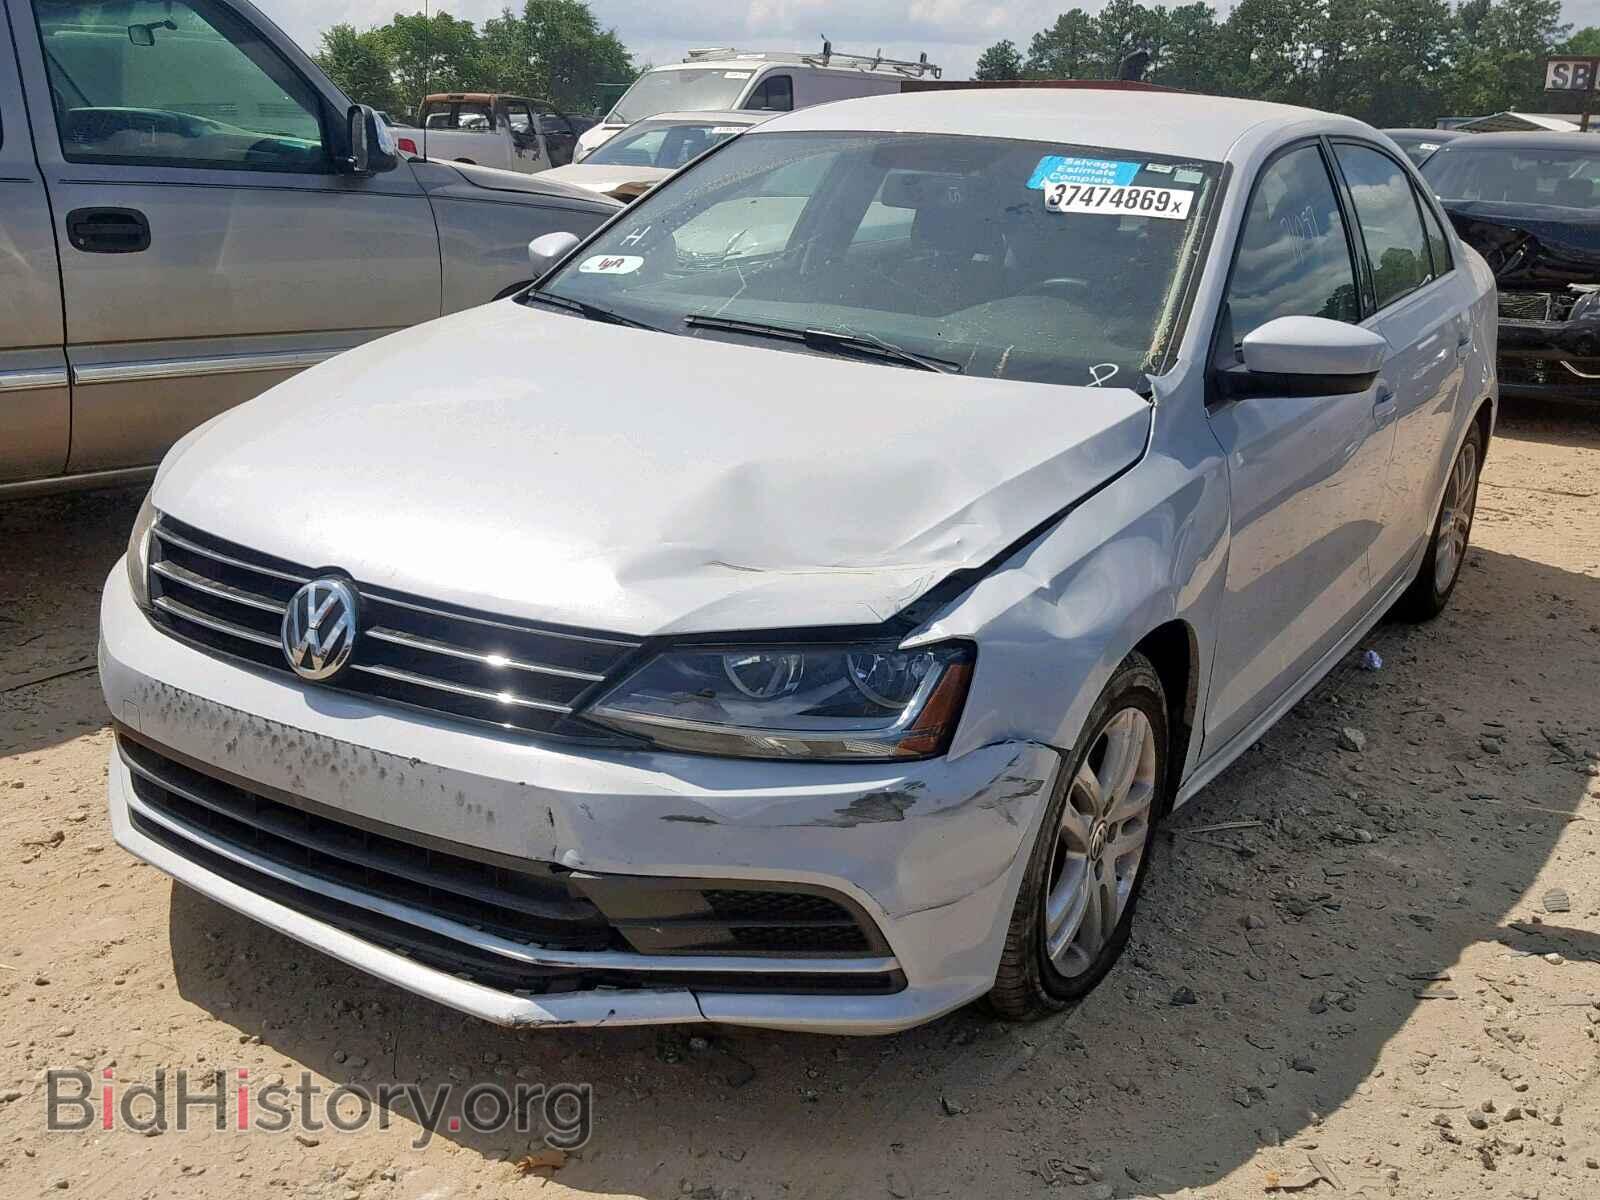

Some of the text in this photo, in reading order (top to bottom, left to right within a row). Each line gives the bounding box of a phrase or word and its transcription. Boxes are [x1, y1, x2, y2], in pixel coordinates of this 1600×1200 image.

[1063, 157, 1118, 169] Salvage
[1055, 165, 1116, 177] Estimate
[1050, 172, 1115, 185] Complete
